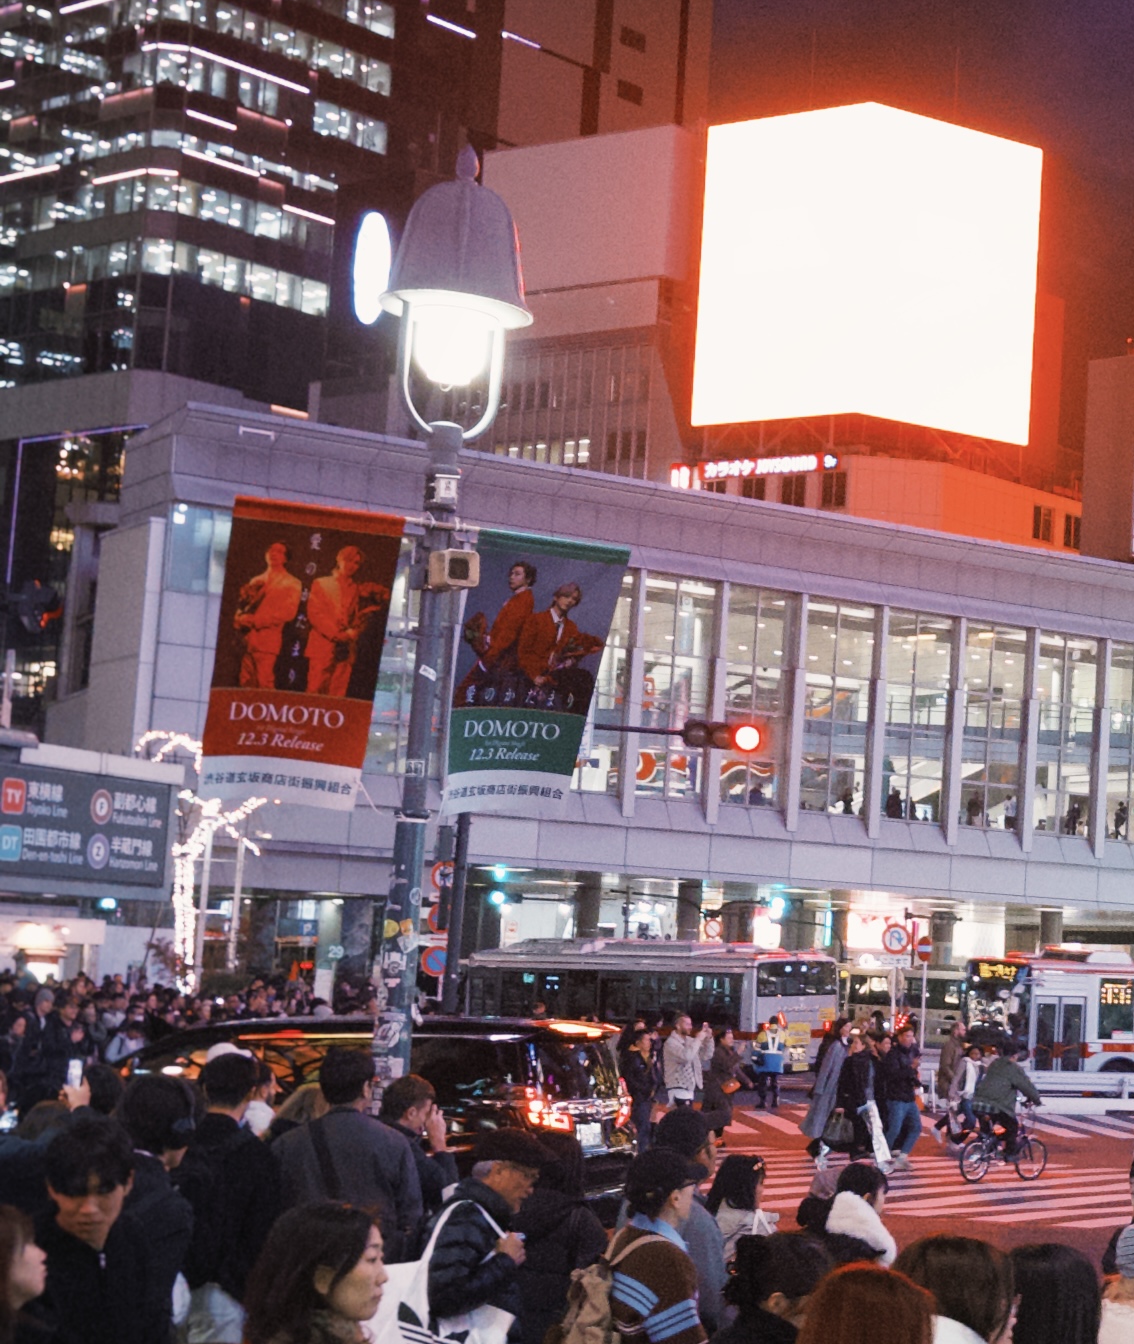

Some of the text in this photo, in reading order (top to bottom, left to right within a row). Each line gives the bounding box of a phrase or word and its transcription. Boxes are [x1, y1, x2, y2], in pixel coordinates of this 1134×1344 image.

[704, 459, 755, 478] カラオケ
[229, 702, 344, 728] DOMOTO
[464, 719, 560, 740] DOMOTO
[237, 732, 325, 751] 12.3 Release
[469, 747, 540, 761] 12.3 Release
[6, 788, 22, 804] TY
[2, 835, 18, 850] DT
[328, 945, 345, 959] 29
